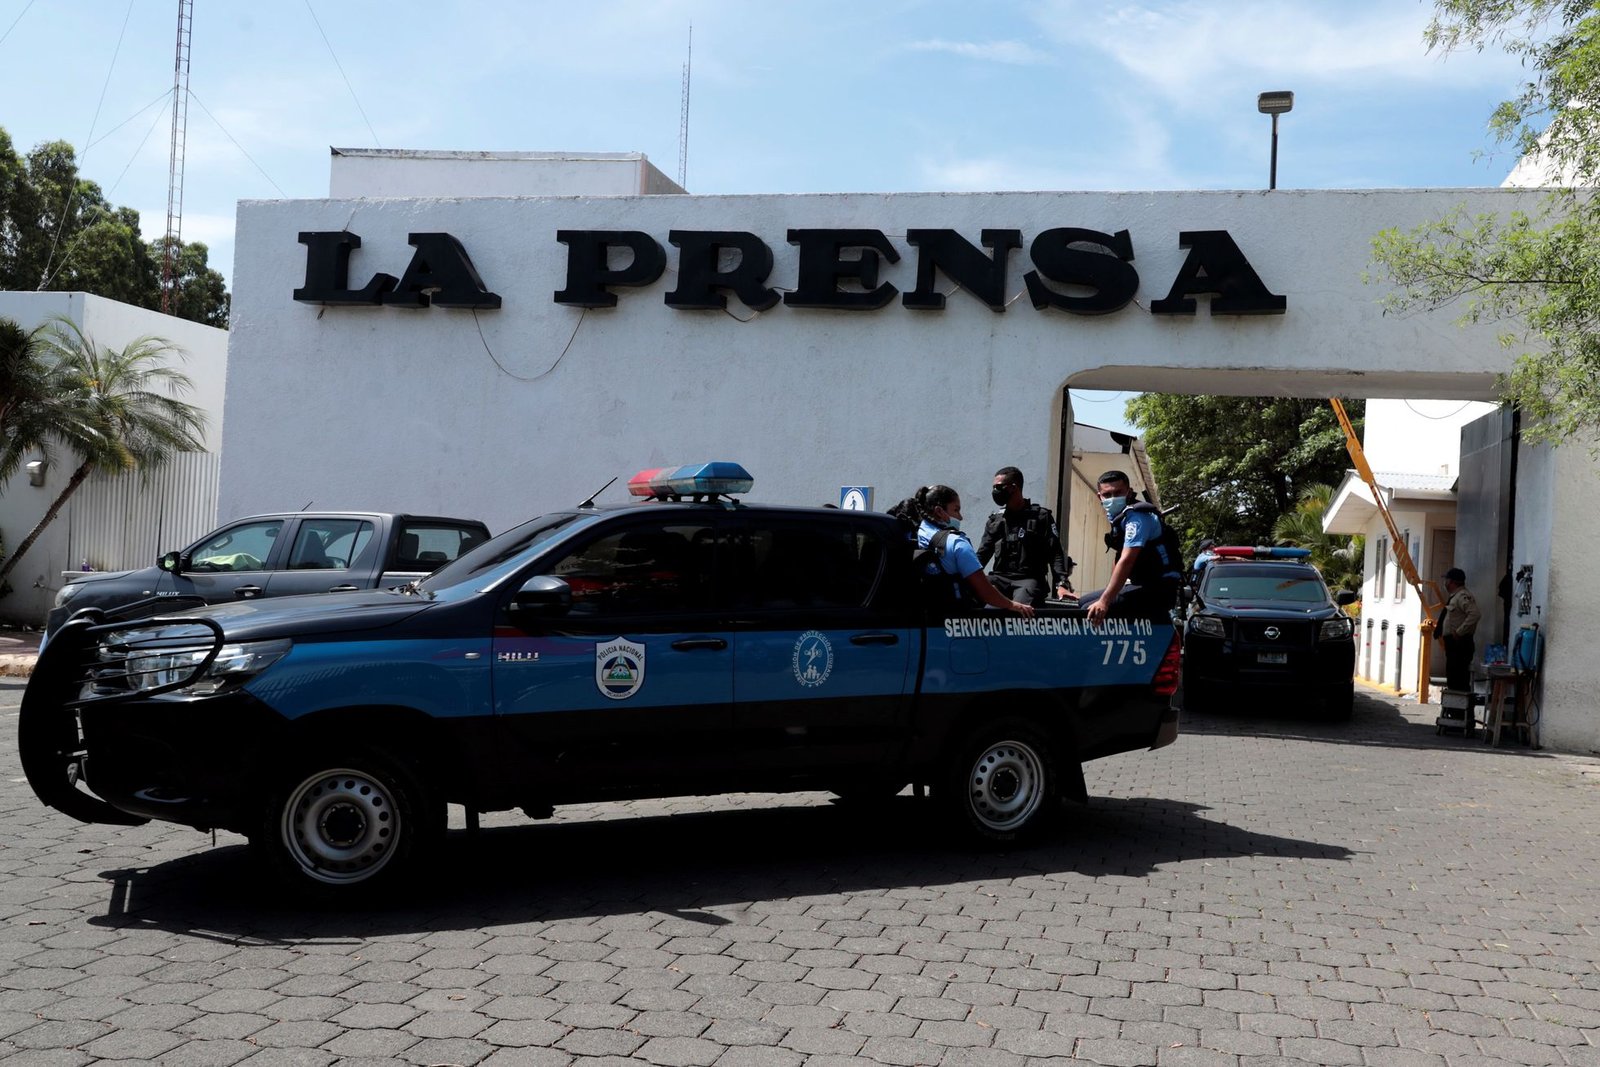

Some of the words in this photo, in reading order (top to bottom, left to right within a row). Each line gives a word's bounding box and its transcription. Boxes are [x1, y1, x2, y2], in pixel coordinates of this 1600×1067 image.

[294, 231, 502, 309] LA
[554, 227, 1287, 315] PRENSA
[944, 618, 1003, 637] SERVICIO
[1005, 617, 1081, 636] EMERGENCIA
[1082, 618, 1132, 636] POLICIAL
[1133, 618, 1153, 636] 118
[497, 652, 540, 662] HILU
[598, 645, 617, 660] POLICIA
[619, 645, 643, 662] NACIONAL
[1101, 640, 1147, 665] 775
